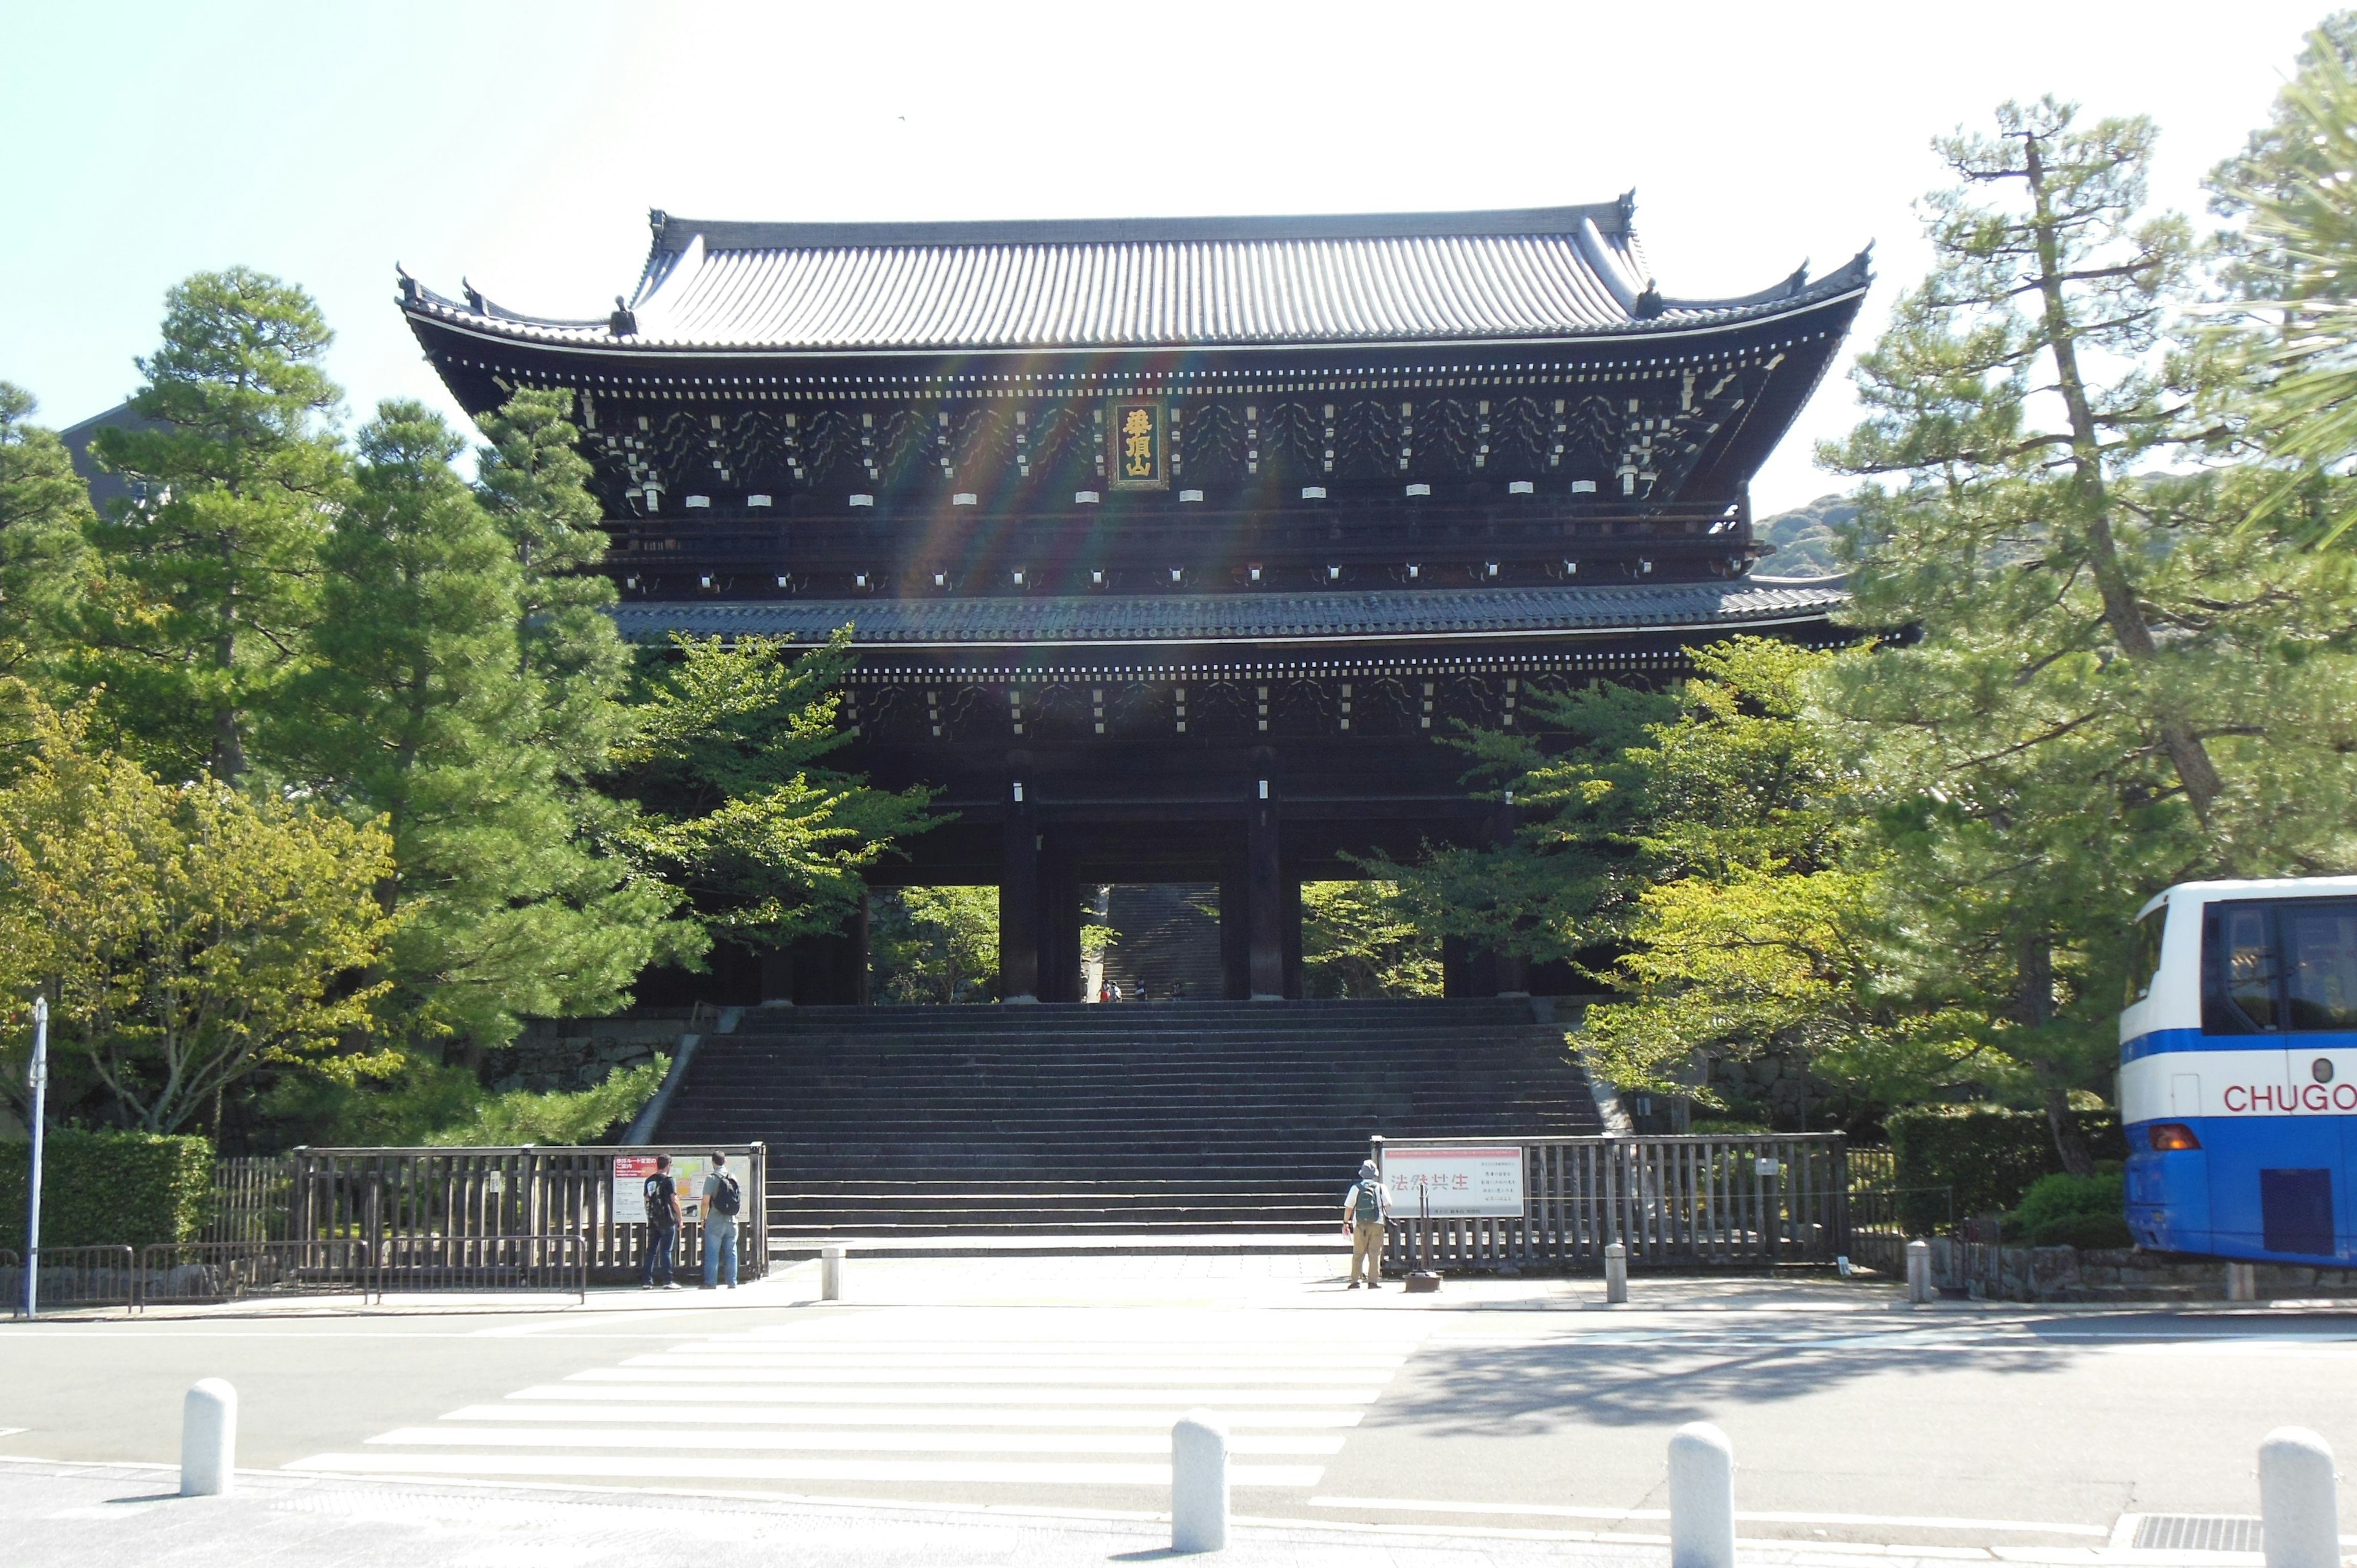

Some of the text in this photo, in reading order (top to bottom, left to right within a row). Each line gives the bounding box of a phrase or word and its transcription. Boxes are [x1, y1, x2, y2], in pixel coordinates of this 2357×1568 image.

[1122, 409, 1153, 477] 華頂山
[2224, 1084, 2357, 1112] CHUGO
[1391, 1173, 1469, 1191] 法然共生
